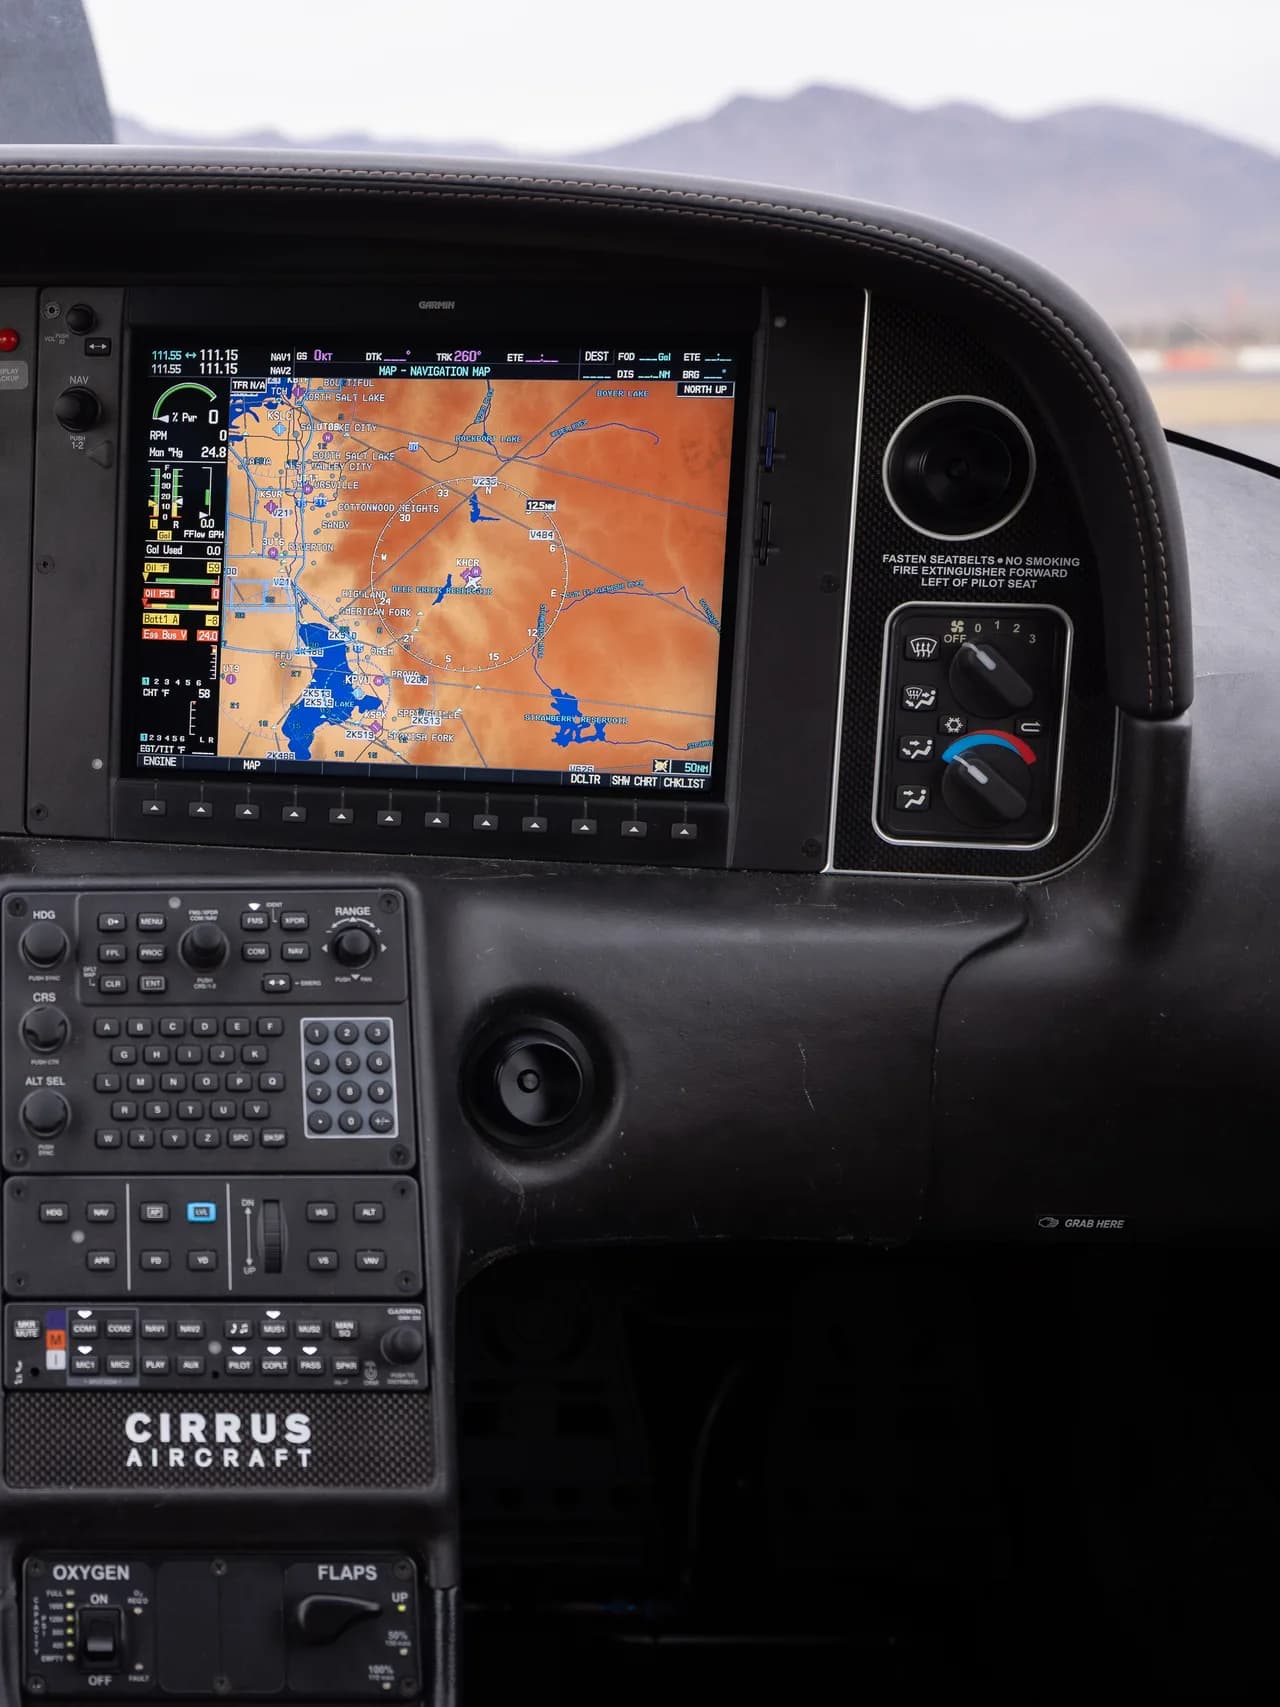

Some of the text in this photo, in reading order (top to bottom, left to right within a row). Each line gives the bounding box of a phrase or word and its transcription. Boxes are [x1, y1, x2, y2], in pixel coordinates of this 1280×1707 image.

[152, 350, 238, 360] 111.55 111.15
[271, 352, 291, 361] NAV1
[585, 352, 608, 361] DEST
[152, 364, 238, 374] 111.55 111.15
[270, 366, 291, 375] NAV2
[379, 366, 491, 377] MAP NAVIGATION MAP
[70, 376, 89, 384] NAV
[684, 385, 727, 393] NORTH UP
[338, 504, 394, 512] COTTONWOOD
[322, 521, 350, 529] SANDY
[883, 554, 1080, 566] FASTEN SEATBELTS NO SMOKING
[893, 566, 1068, 578] FIRE EXTINGUISHER FORWARD
[921, 578, 1037, 588] LEFT OF PILOT SEAT
[944, 634, 966, 643] OFF
[144, 756, 176, 766] ENGINE
[244, 760, 261, 770] MAP
[571, 774, 600, 784] DCLTR
[612, 775, 658, 786] SHW CHRT
[663, 777, 705, 788] CHKLIST
[33, 911, 55, 919] HDG
[335, 907, 370, 916] RANGE
[33, 993, 56, 1002] CRS
[25, 1077, 65, 1086] ALT SEL
[1065, 1219, 1125, 1228] GRAB HERE
[125, 1412, 311, 1444] CIRRUS
[126, 1448, 311, 1468] AIRCRAFT
[53, 1566, 130, 1580] OXYGEN
[318, 1566, 377, 1580] FLAPS
[91, 1594, 108, 1604] ON
[392, 1592, 408, 1602] UP
[88, 1676, 112, 1686] OFF
